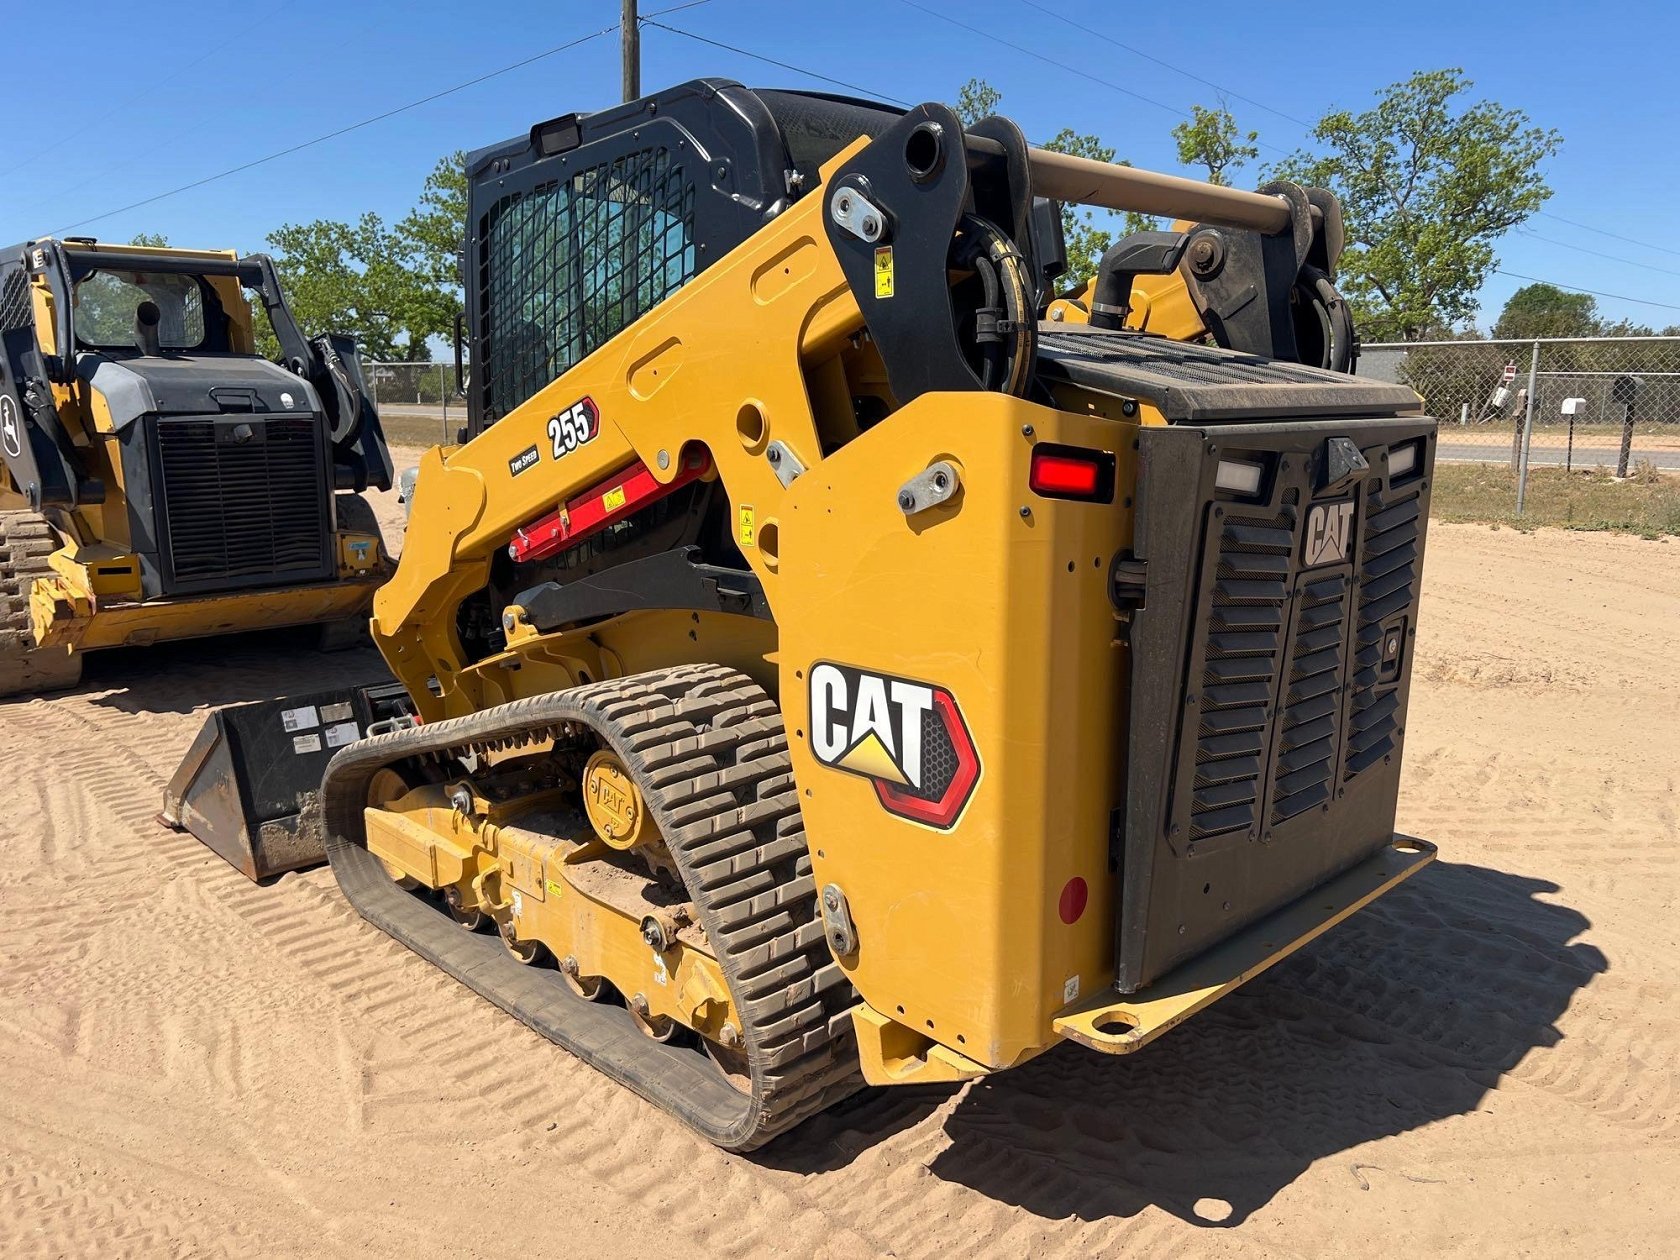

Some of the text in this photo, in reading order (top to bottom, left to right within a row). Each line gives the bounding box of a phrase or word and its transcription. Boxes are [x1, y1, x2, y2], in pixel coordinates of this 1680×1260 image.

[548, 402, 589, 458] 255
[1305, 502, 1354, 565] CAT
[811, 664, 933, 789] CAT
[603, 786, 625, 815] CAT
